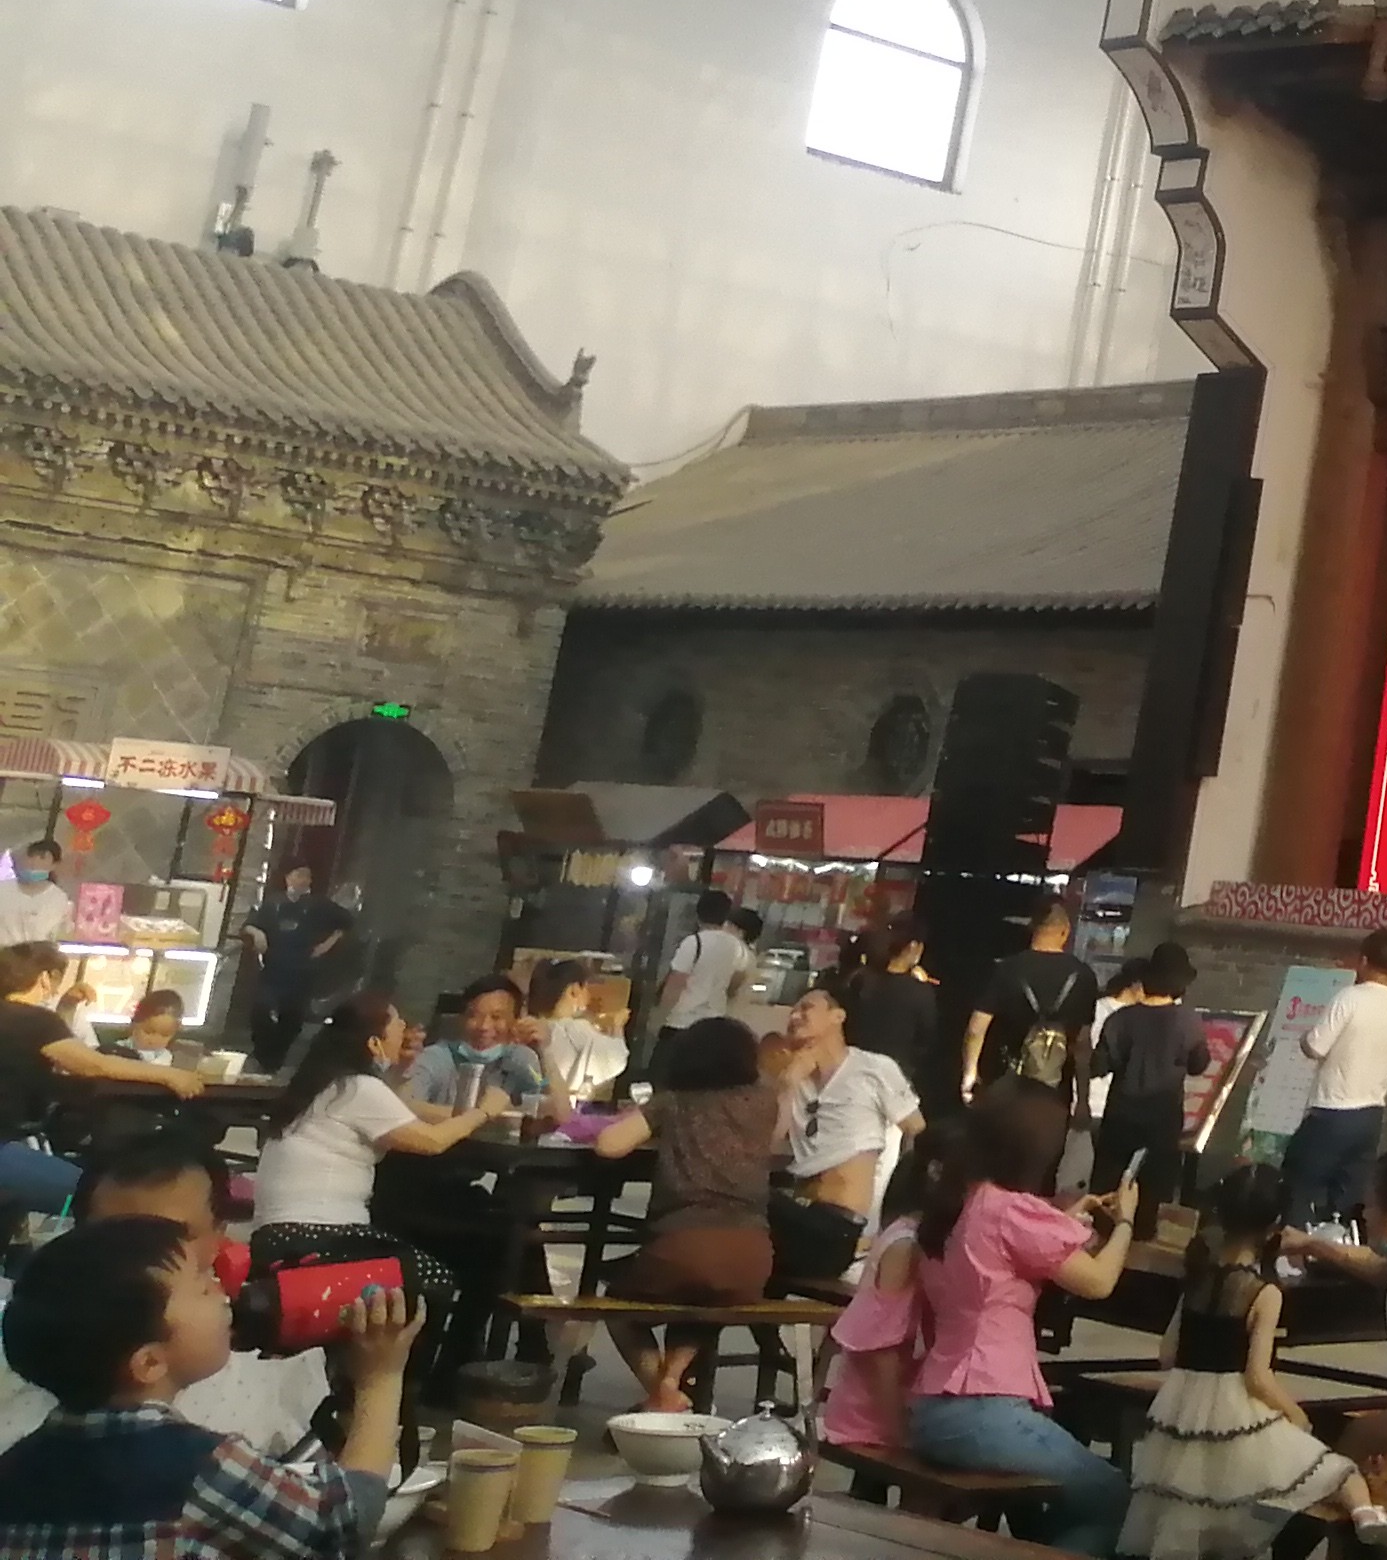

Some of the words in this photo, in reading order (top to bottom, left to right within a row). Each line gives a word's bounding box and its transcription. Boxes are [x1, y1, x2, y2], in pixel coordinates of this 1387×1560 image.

[119, 755, 219, 781] 不二冻水果
